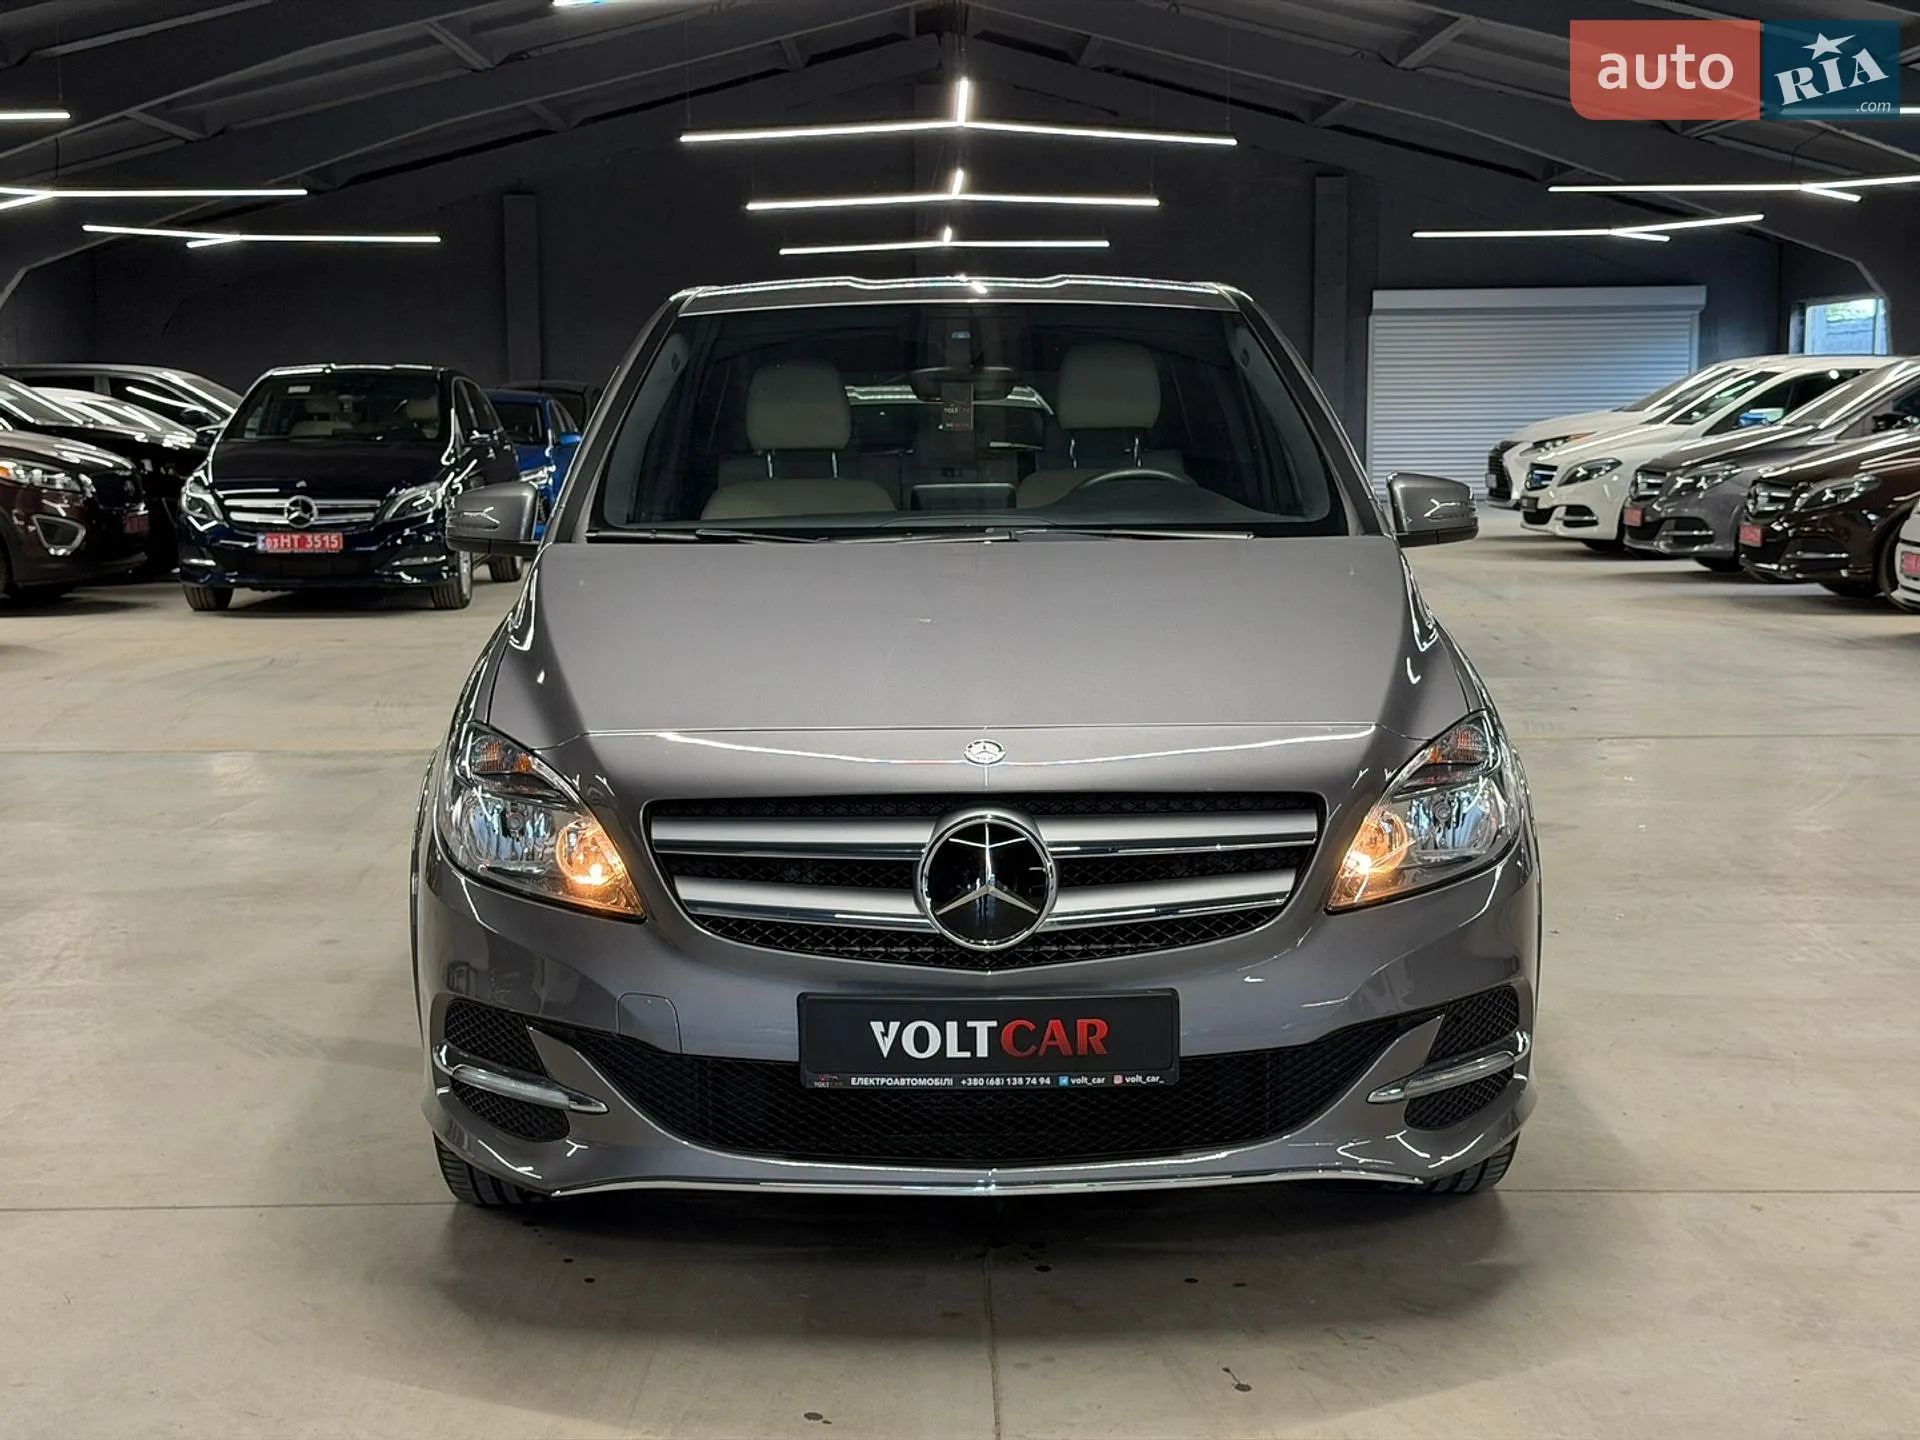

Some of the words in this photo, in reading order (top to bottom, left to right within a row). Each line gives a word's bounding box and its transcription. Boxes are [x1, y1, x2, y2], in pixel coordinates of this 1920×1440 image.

[306, 533, 339, 549] 3515
[960, 1077, 985, 1087] +380
[1006, 1077, 1024, 1086] 138
[1025, 1077, 1037, 1085] 74
[1039, 1077, 1051, 1085] 94
[1070, 1076, 1106, 1086] volt_car
